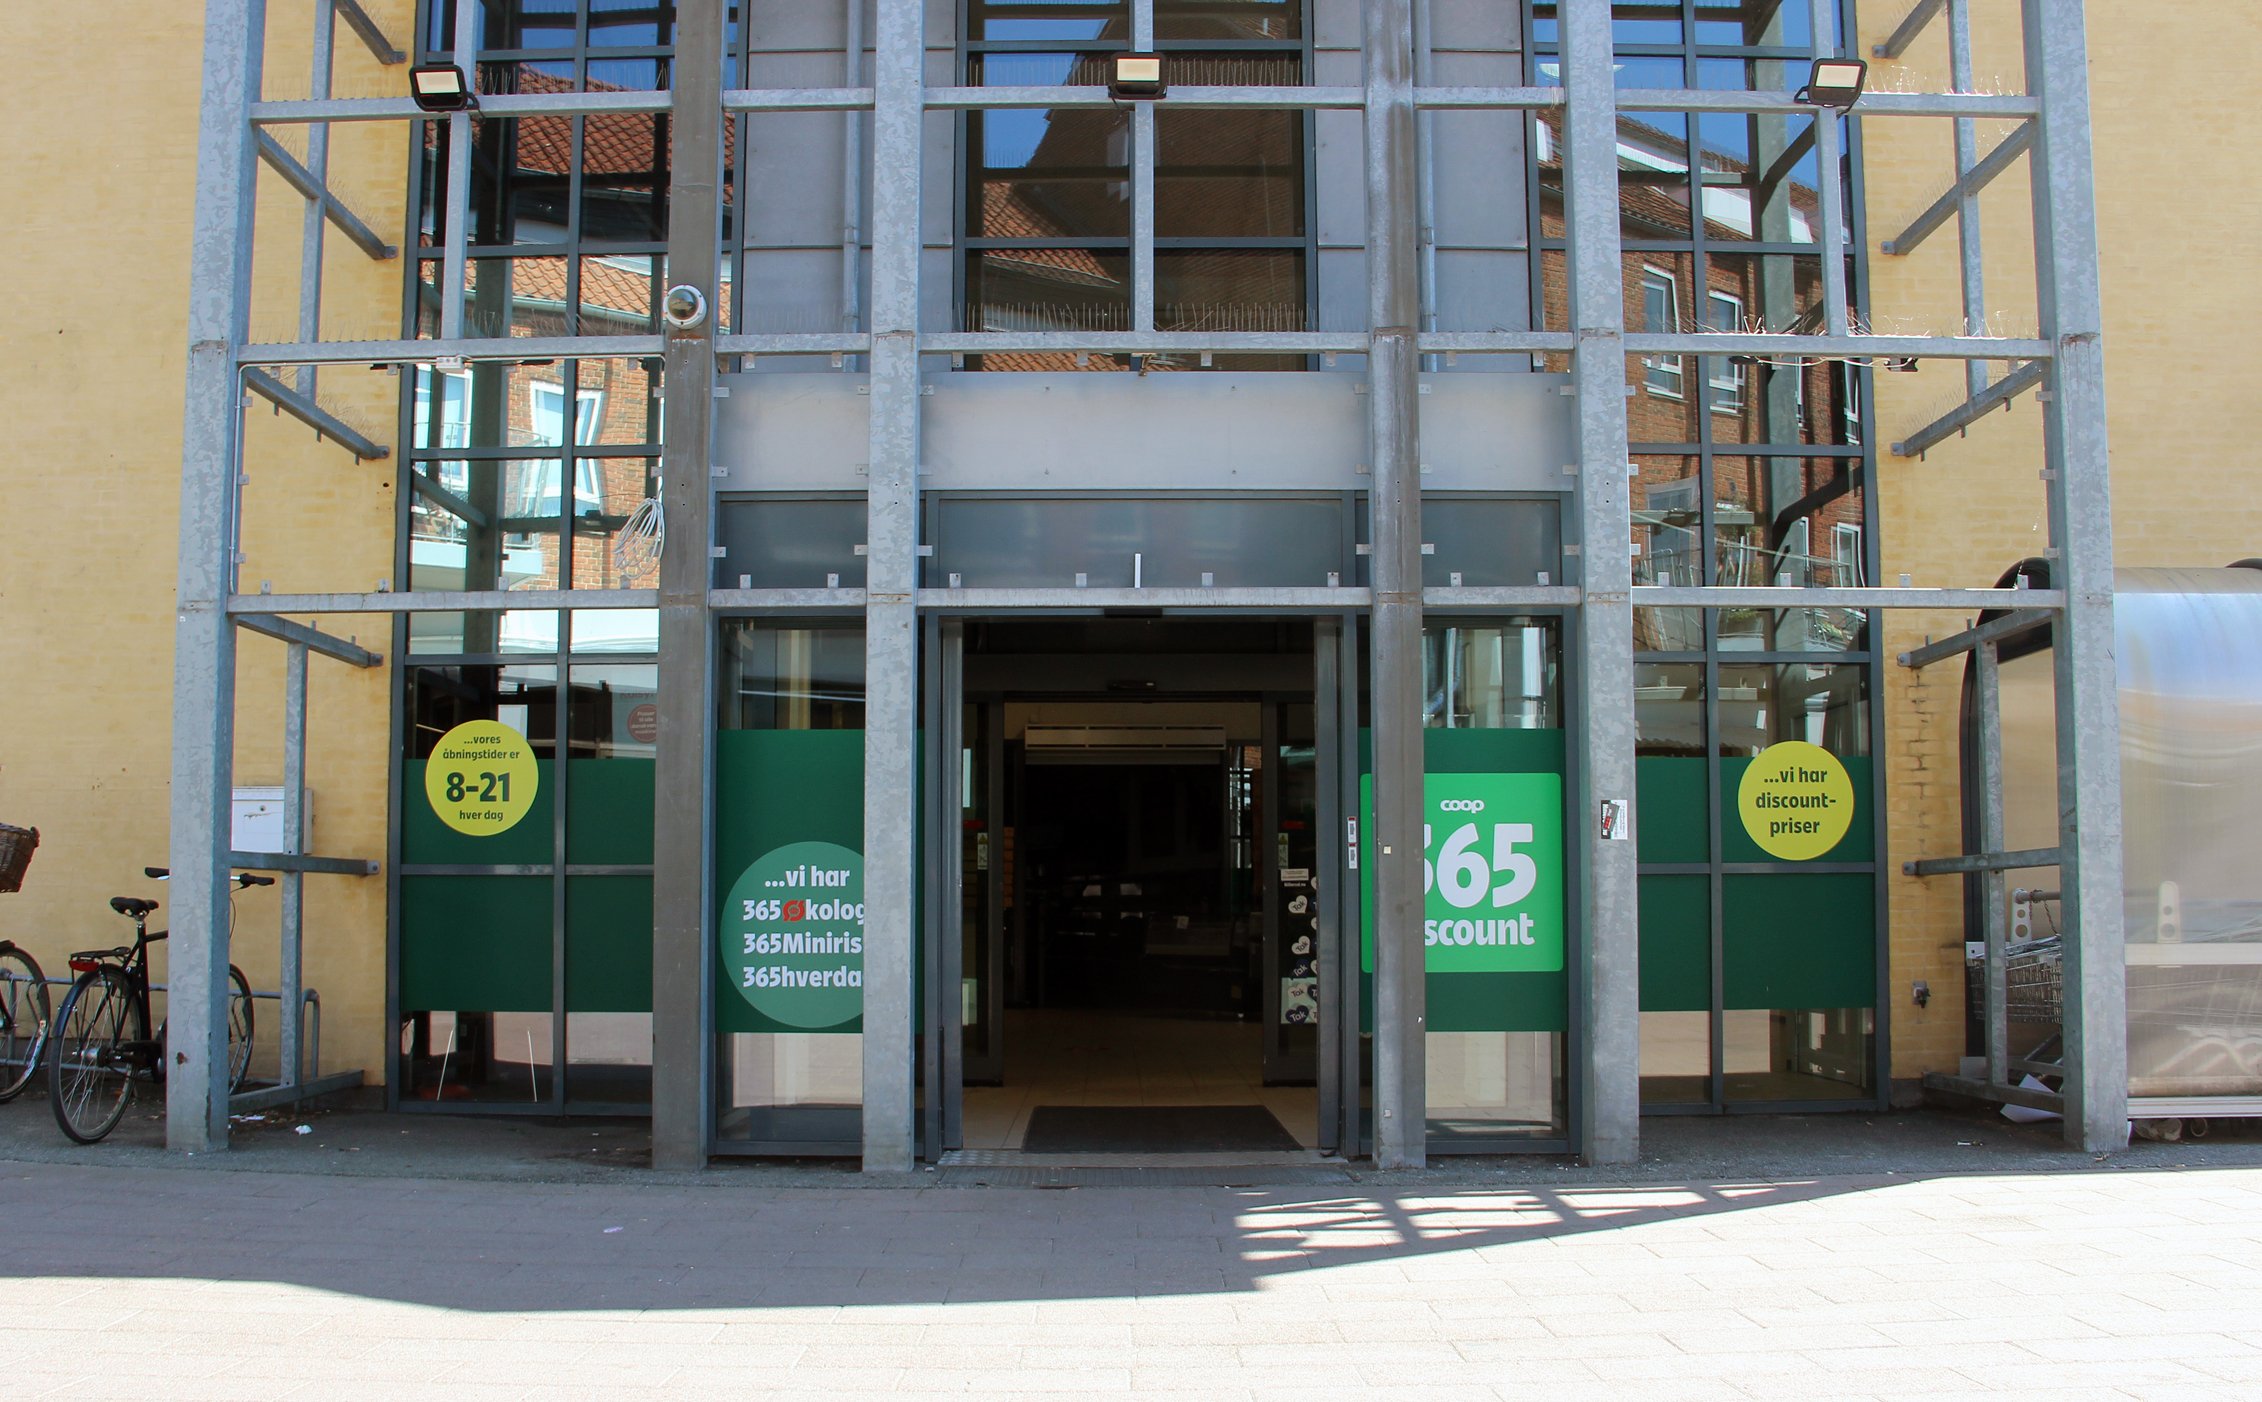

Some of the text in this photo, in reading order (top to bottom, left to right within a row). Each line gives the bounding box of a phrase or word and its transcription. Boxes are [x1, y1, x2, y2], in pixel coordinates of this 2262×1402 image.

[464, 736, 502, 745] ...vores
[443, 748, 520, 761] åbningstider er
[1764, 767, 1828, 783] ...vi har
[446, 771, 510, 802] 8-21
[1440, 799, 1485, 814] coop
[1755, 792, 1836, 808] discount-
[459, 810, 503, 822] hver dag
[1770, 817, 1820, 837] priser
[1424, 822, 1537, 908] 65
[765, 865, 850, 887] ...vi har
[743, 931, 862, 954] 365Miniris
[743, 966, 862, 987] 365hverda
